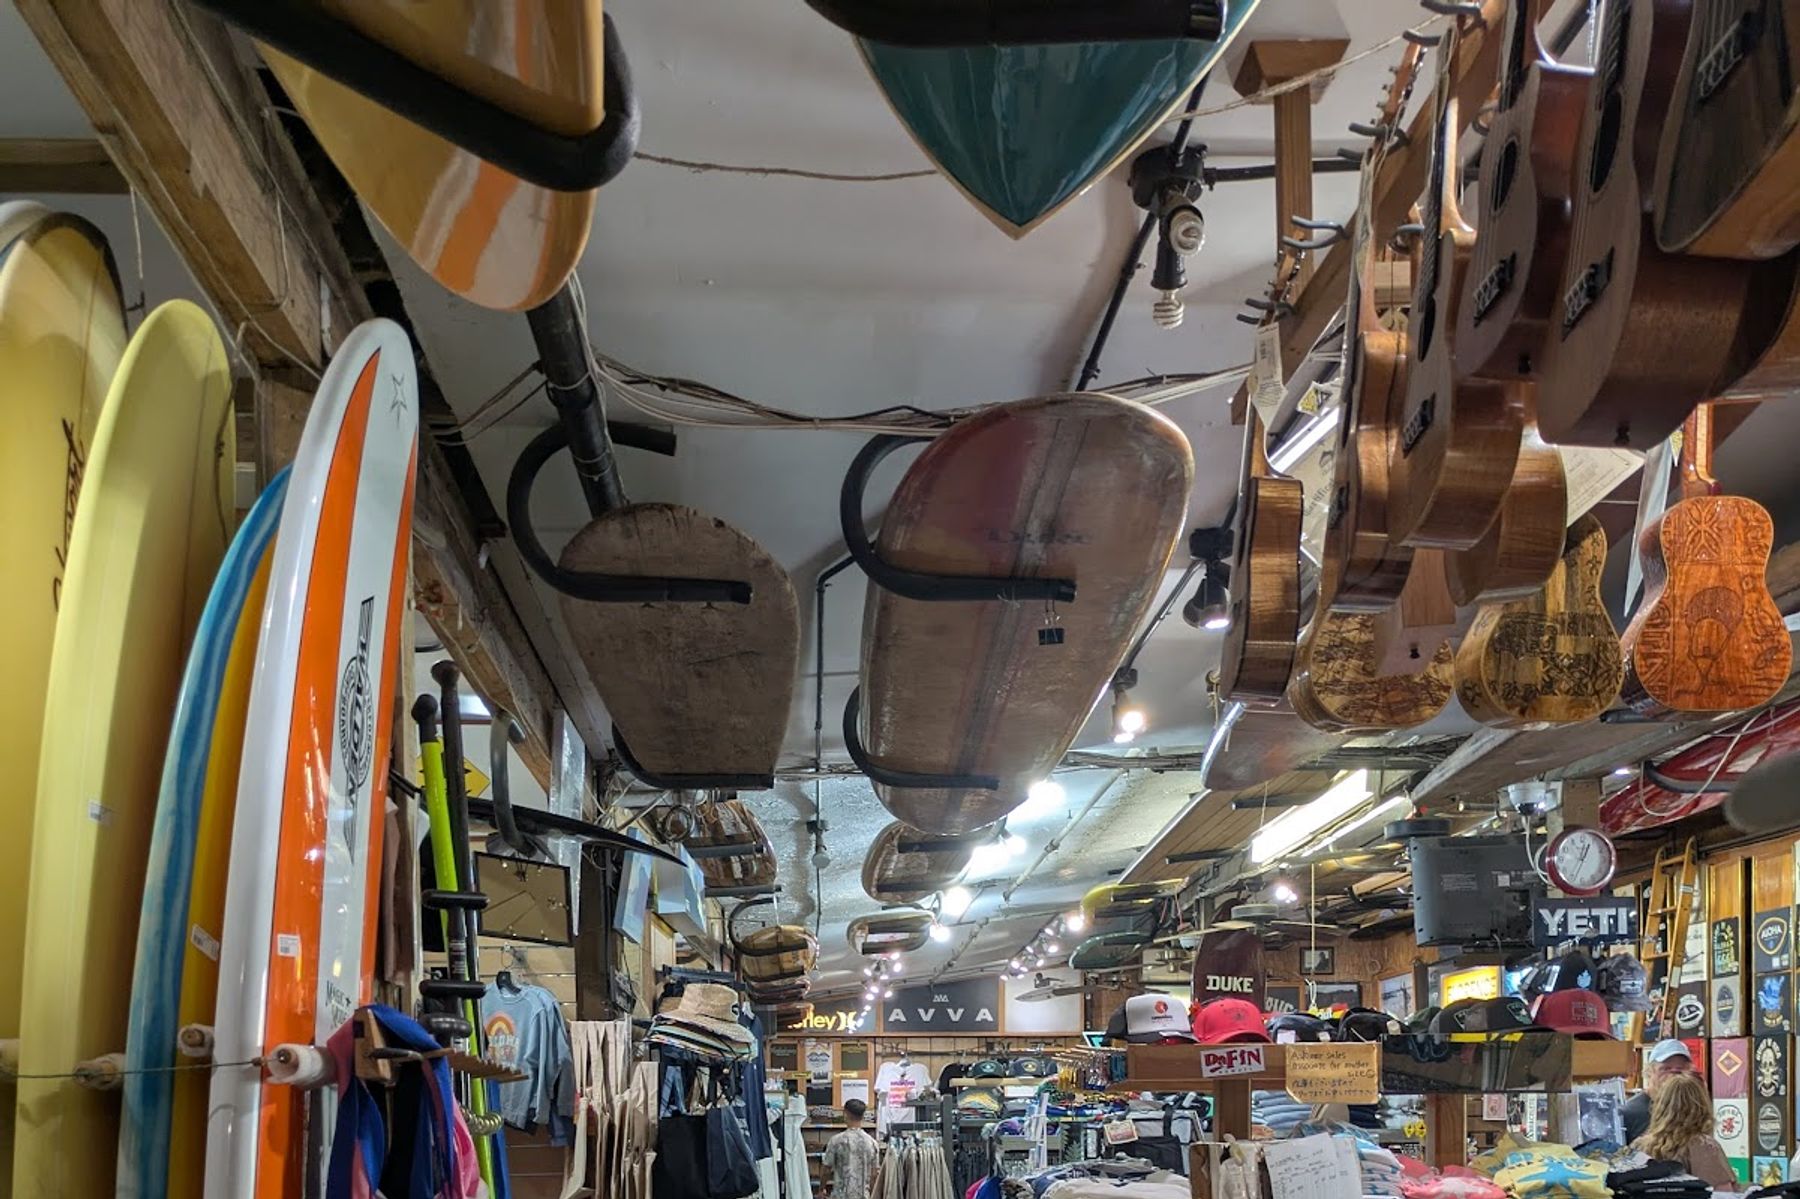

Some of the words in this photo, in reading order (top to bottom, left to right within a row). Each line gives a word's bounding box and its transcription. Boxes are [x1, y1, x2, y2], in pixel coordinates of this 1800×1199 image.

[1539, 907, 1629, 937] YETI
[1206, 975, 1254, 993] DUKE
[888, 1008, 994, 1022] AVVA
